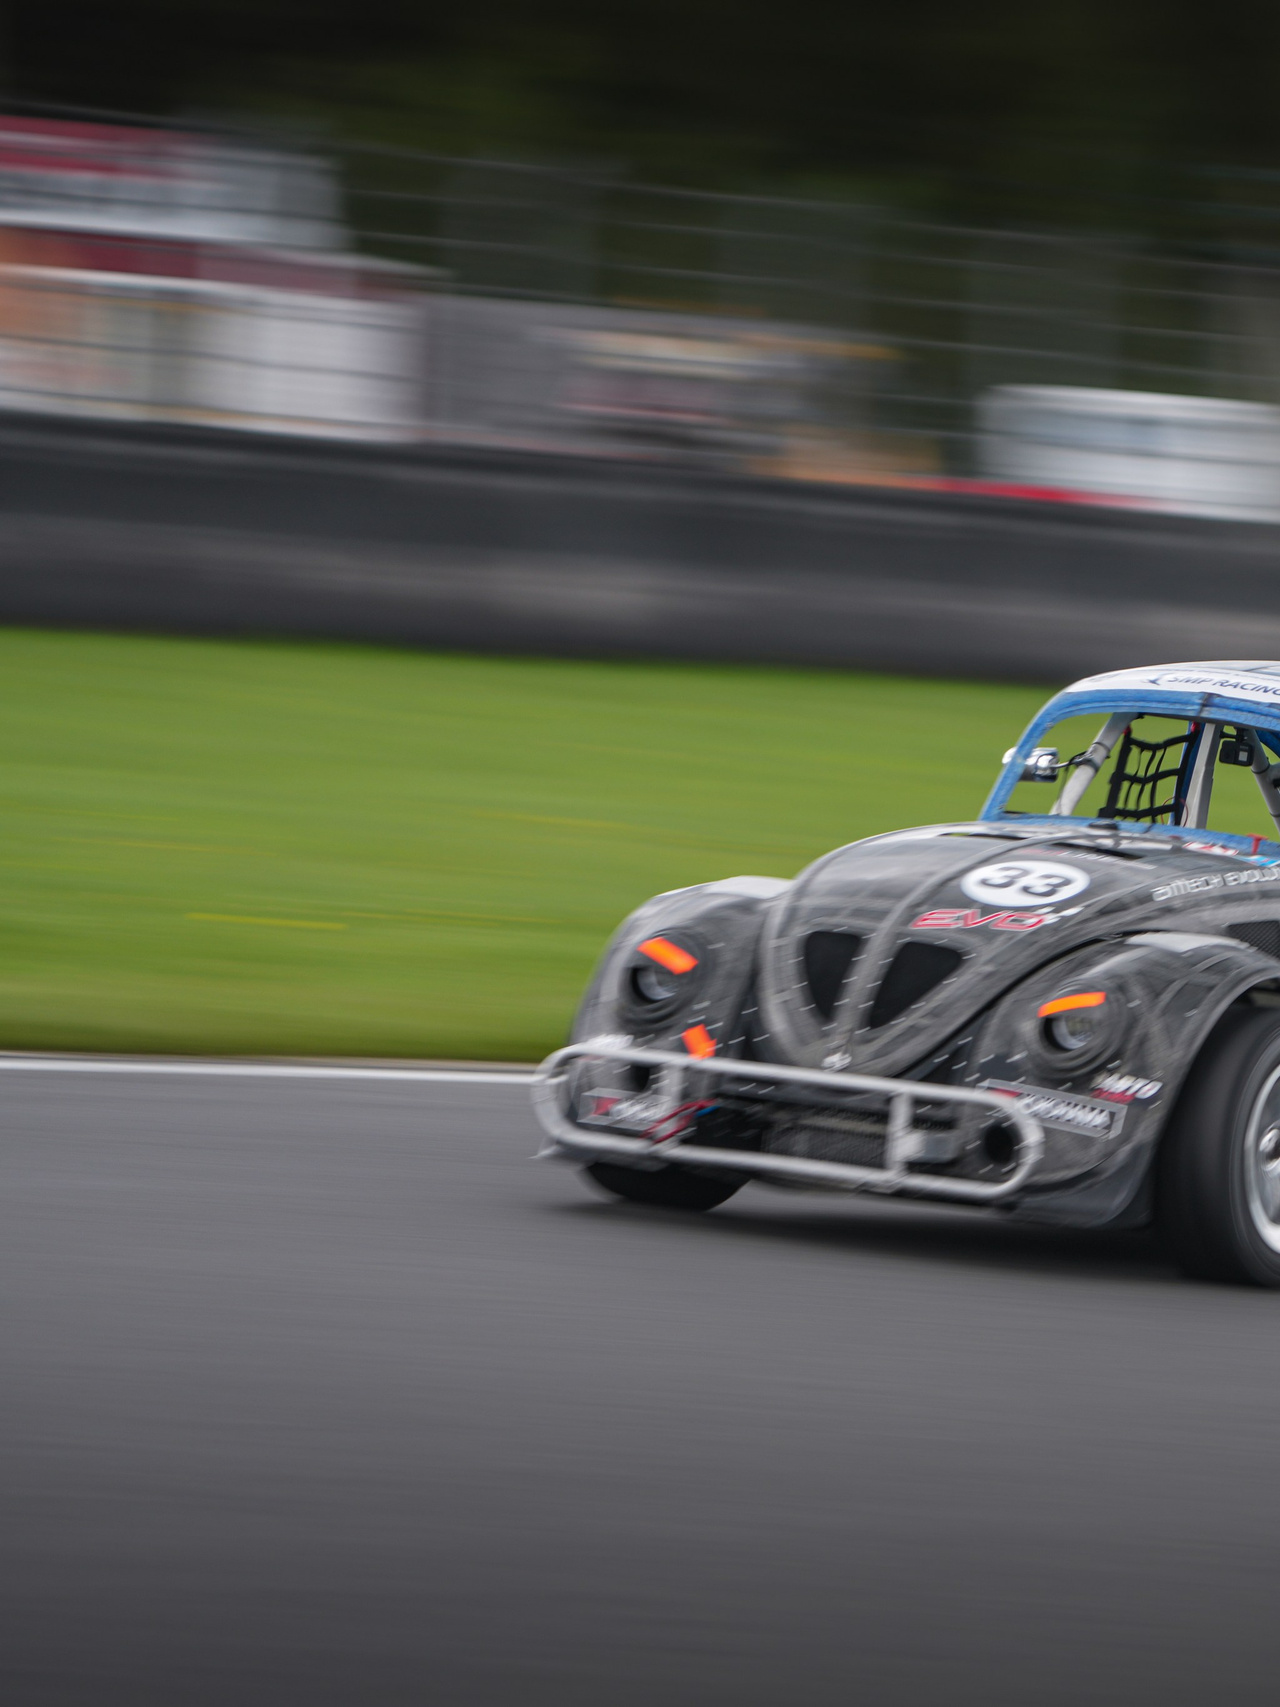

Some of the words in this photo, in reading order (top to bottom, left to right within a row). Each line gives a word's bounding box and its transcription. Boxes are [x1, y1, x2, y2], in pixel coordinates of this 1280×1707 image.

[1166, 674, 1212, 686] SMP
[979, 865, 1074, 898] 33
[908, 908, 1047, 931] EVO
